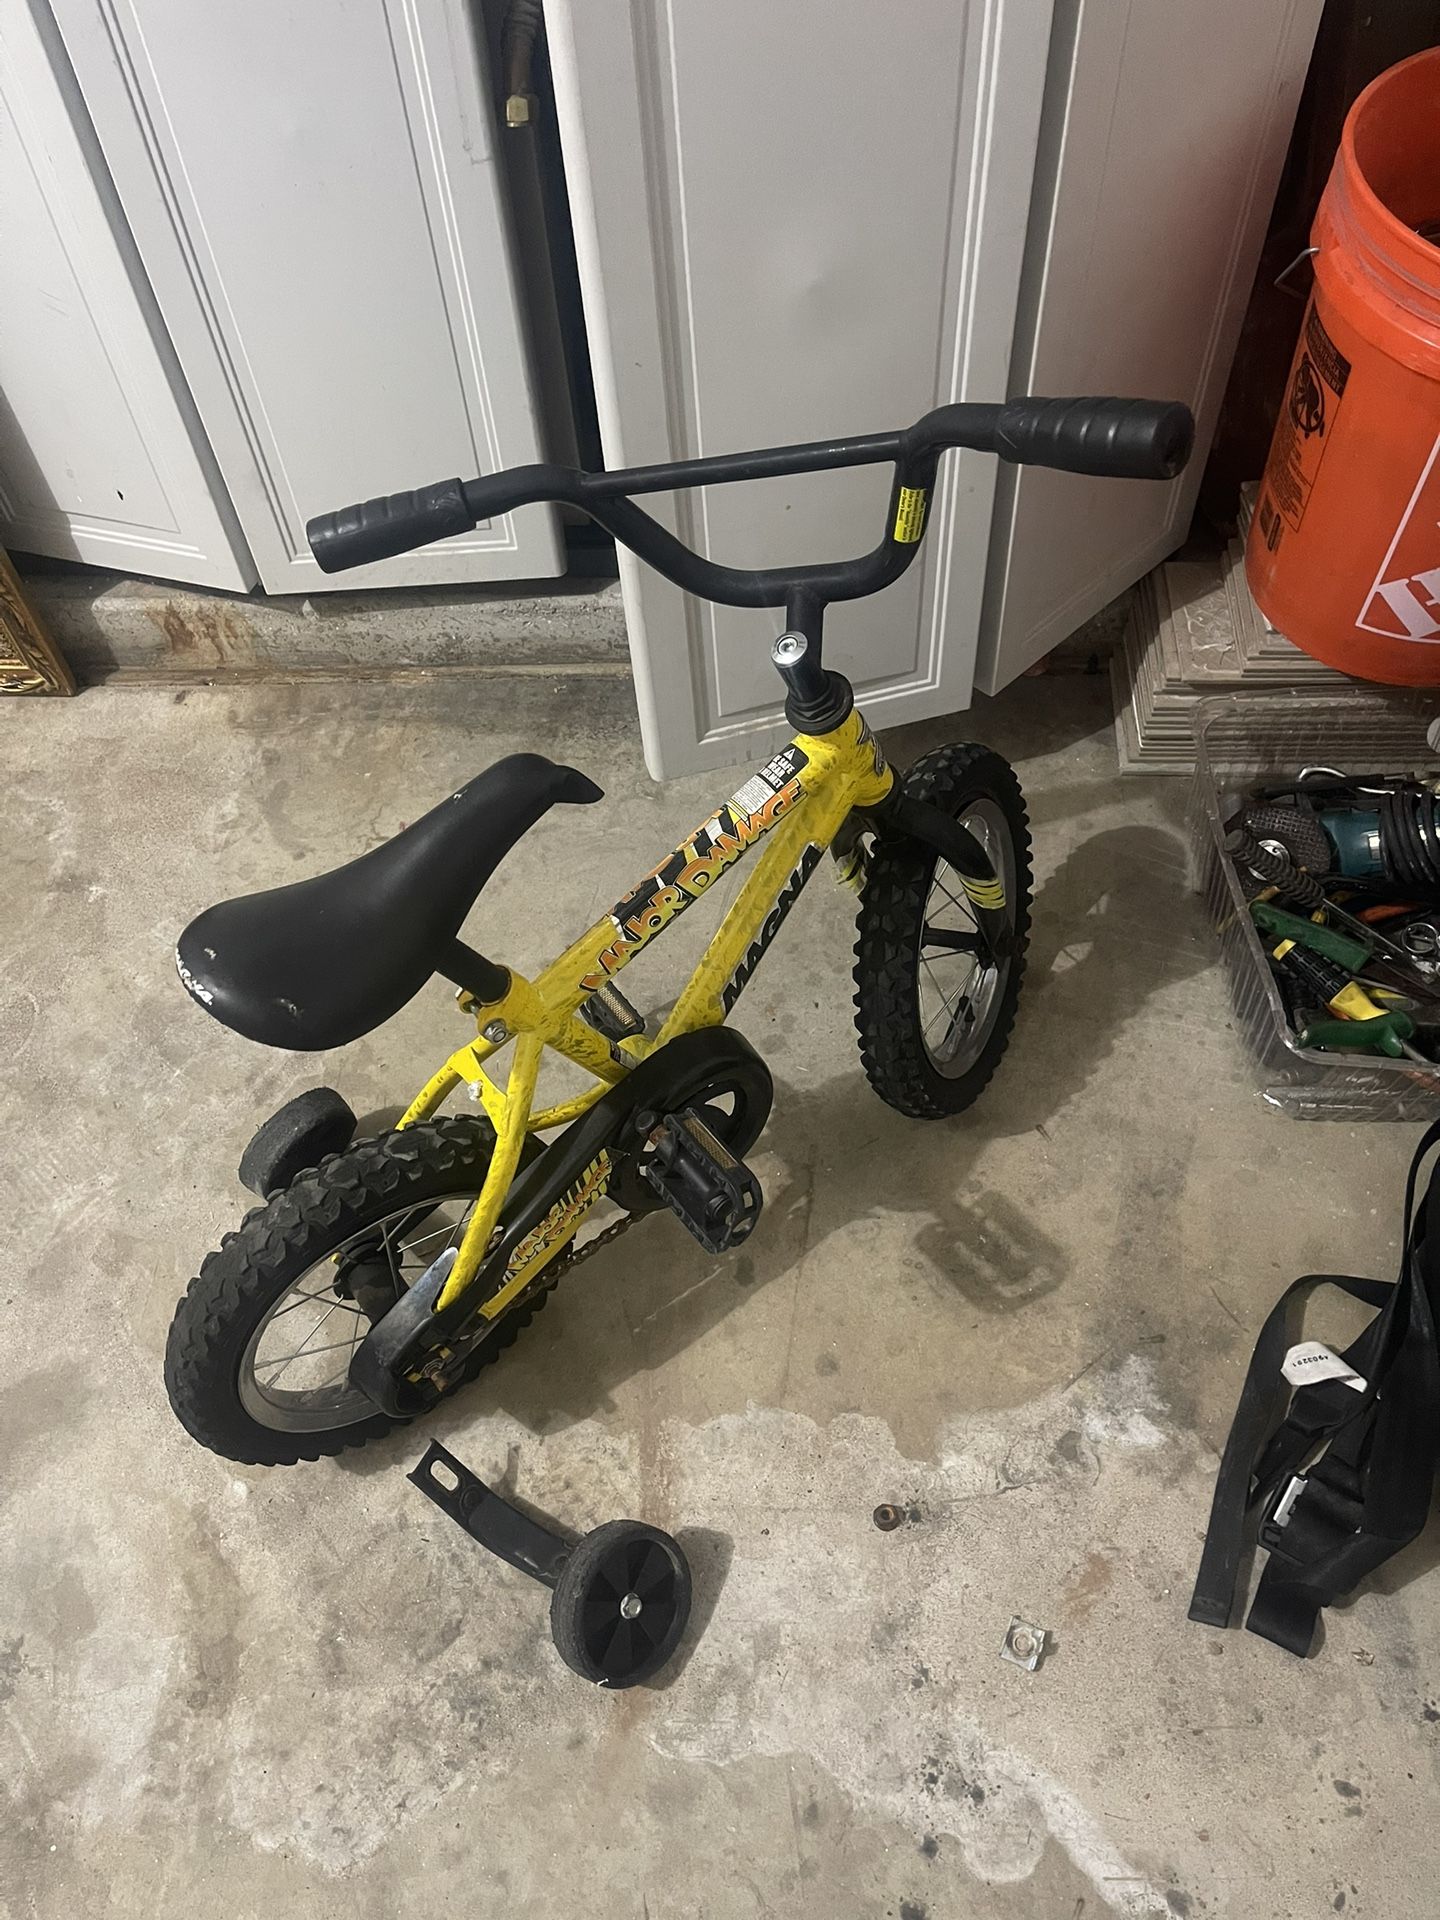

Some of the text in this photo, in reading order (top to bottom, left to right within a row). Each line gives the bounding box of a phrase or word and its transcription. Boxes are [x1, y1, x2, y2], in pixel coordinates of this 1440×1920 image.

[758, 765, 785, 789] HELMET
[767, 761, 786, 778] WEAR
[777, 756, 796, 775] SAFE
[579, 885, 691, 992] MAJOR
[676, 777, 807, 899] DAMAGE
[722, 844, 823, 1018] MAGNA
